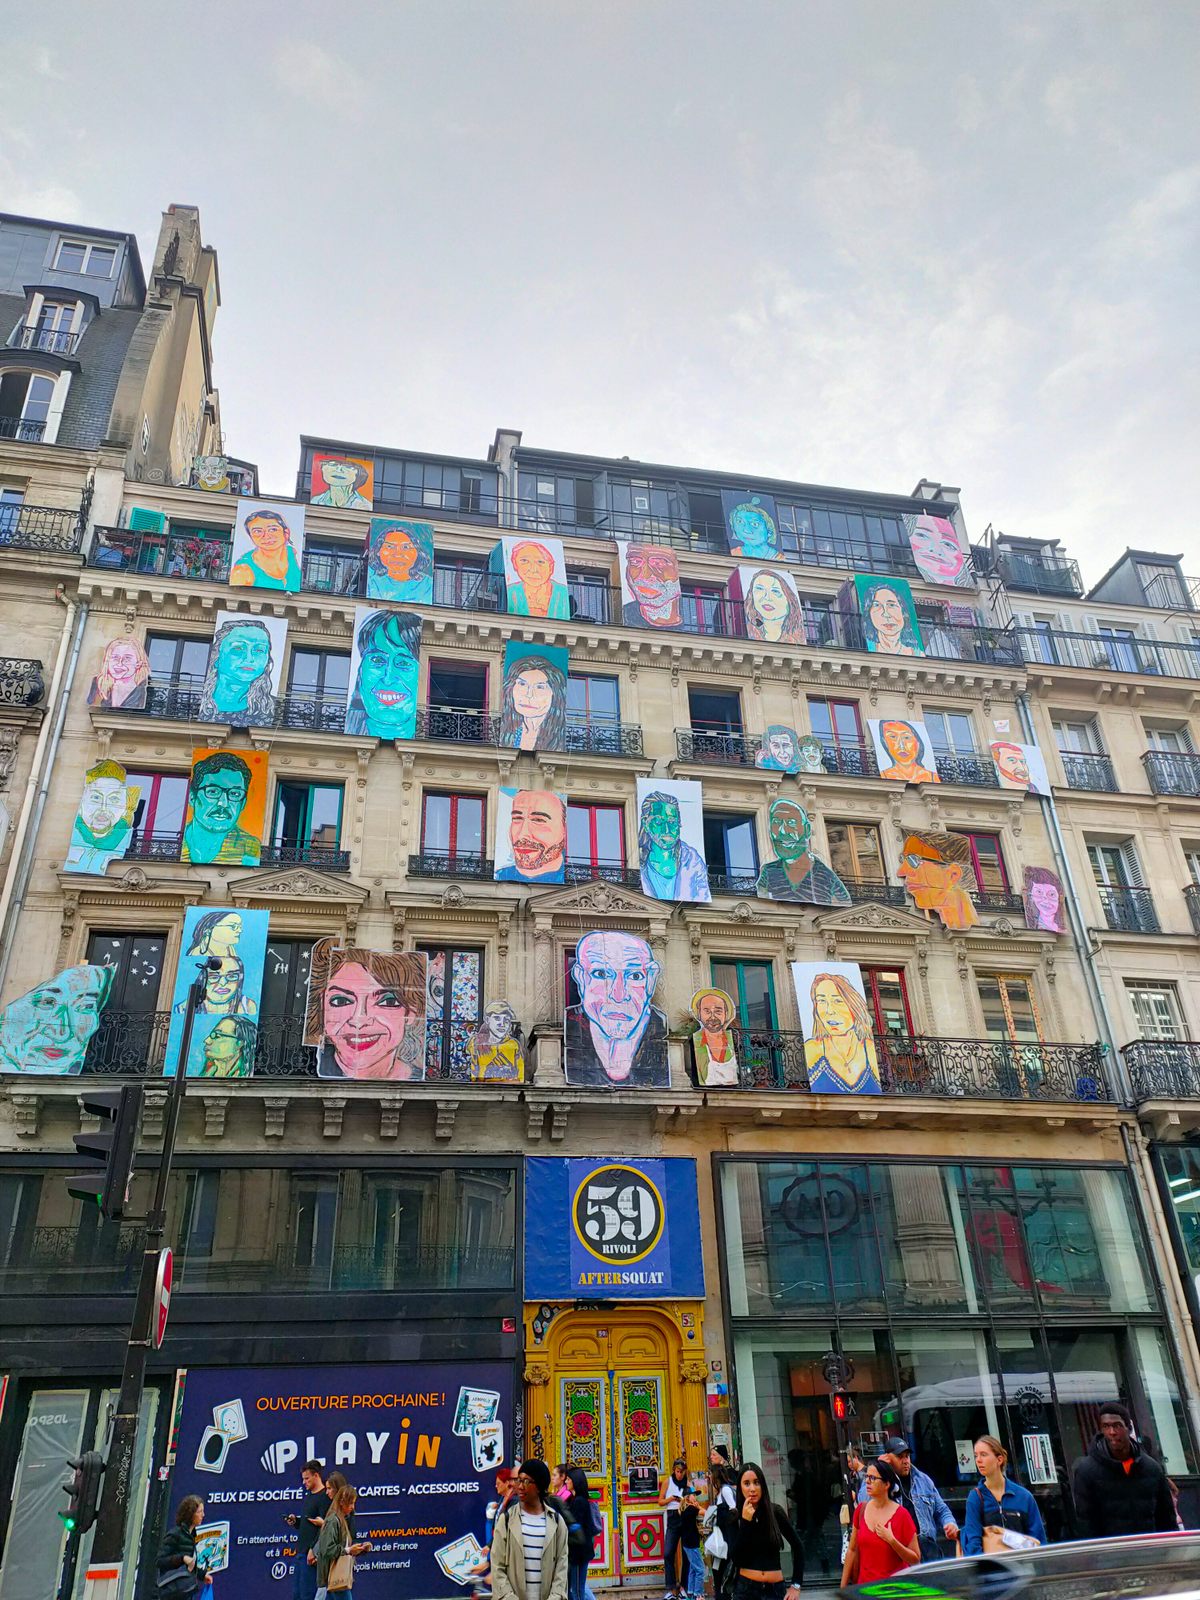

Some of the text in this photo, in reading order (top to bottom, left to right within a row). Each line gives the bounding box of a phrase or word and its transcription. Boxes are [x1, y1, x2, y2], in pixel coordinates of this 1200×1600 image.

[585, 1185, 656, 1241] 59
[602, 1244, 637, 1254] RIVOLI
[578, 1271, 664, 1285] AFTERSQUAT
[256, 1395, 349, 1411] OUVERTURE
[351, 1393, 439, 1409] PROCHAINE
[207, 1491, 237, 1503] JEUX
[238, 1490, 255, 1502] DE
[256, 1487, 304, 1501] SOCIÉTÉ
[358, 1485, 400, 1497] CARTES
[407, 1482, 480, 1495] ACCESSOIRES
[237, 1536, 248, 1545] En
[248, 1535, 289, 1544] attendant,
[356, 1531, 368, 1539] sur
[369, 1526, 447, 1538] WWW.PLAY-IN.COM
[265, 1549, 275, 1558] et
[381, 1543, 393, 1551] de
[392, 1541, 418, 1551] France
[371, 1559, 410, 1570] Mitterrand
